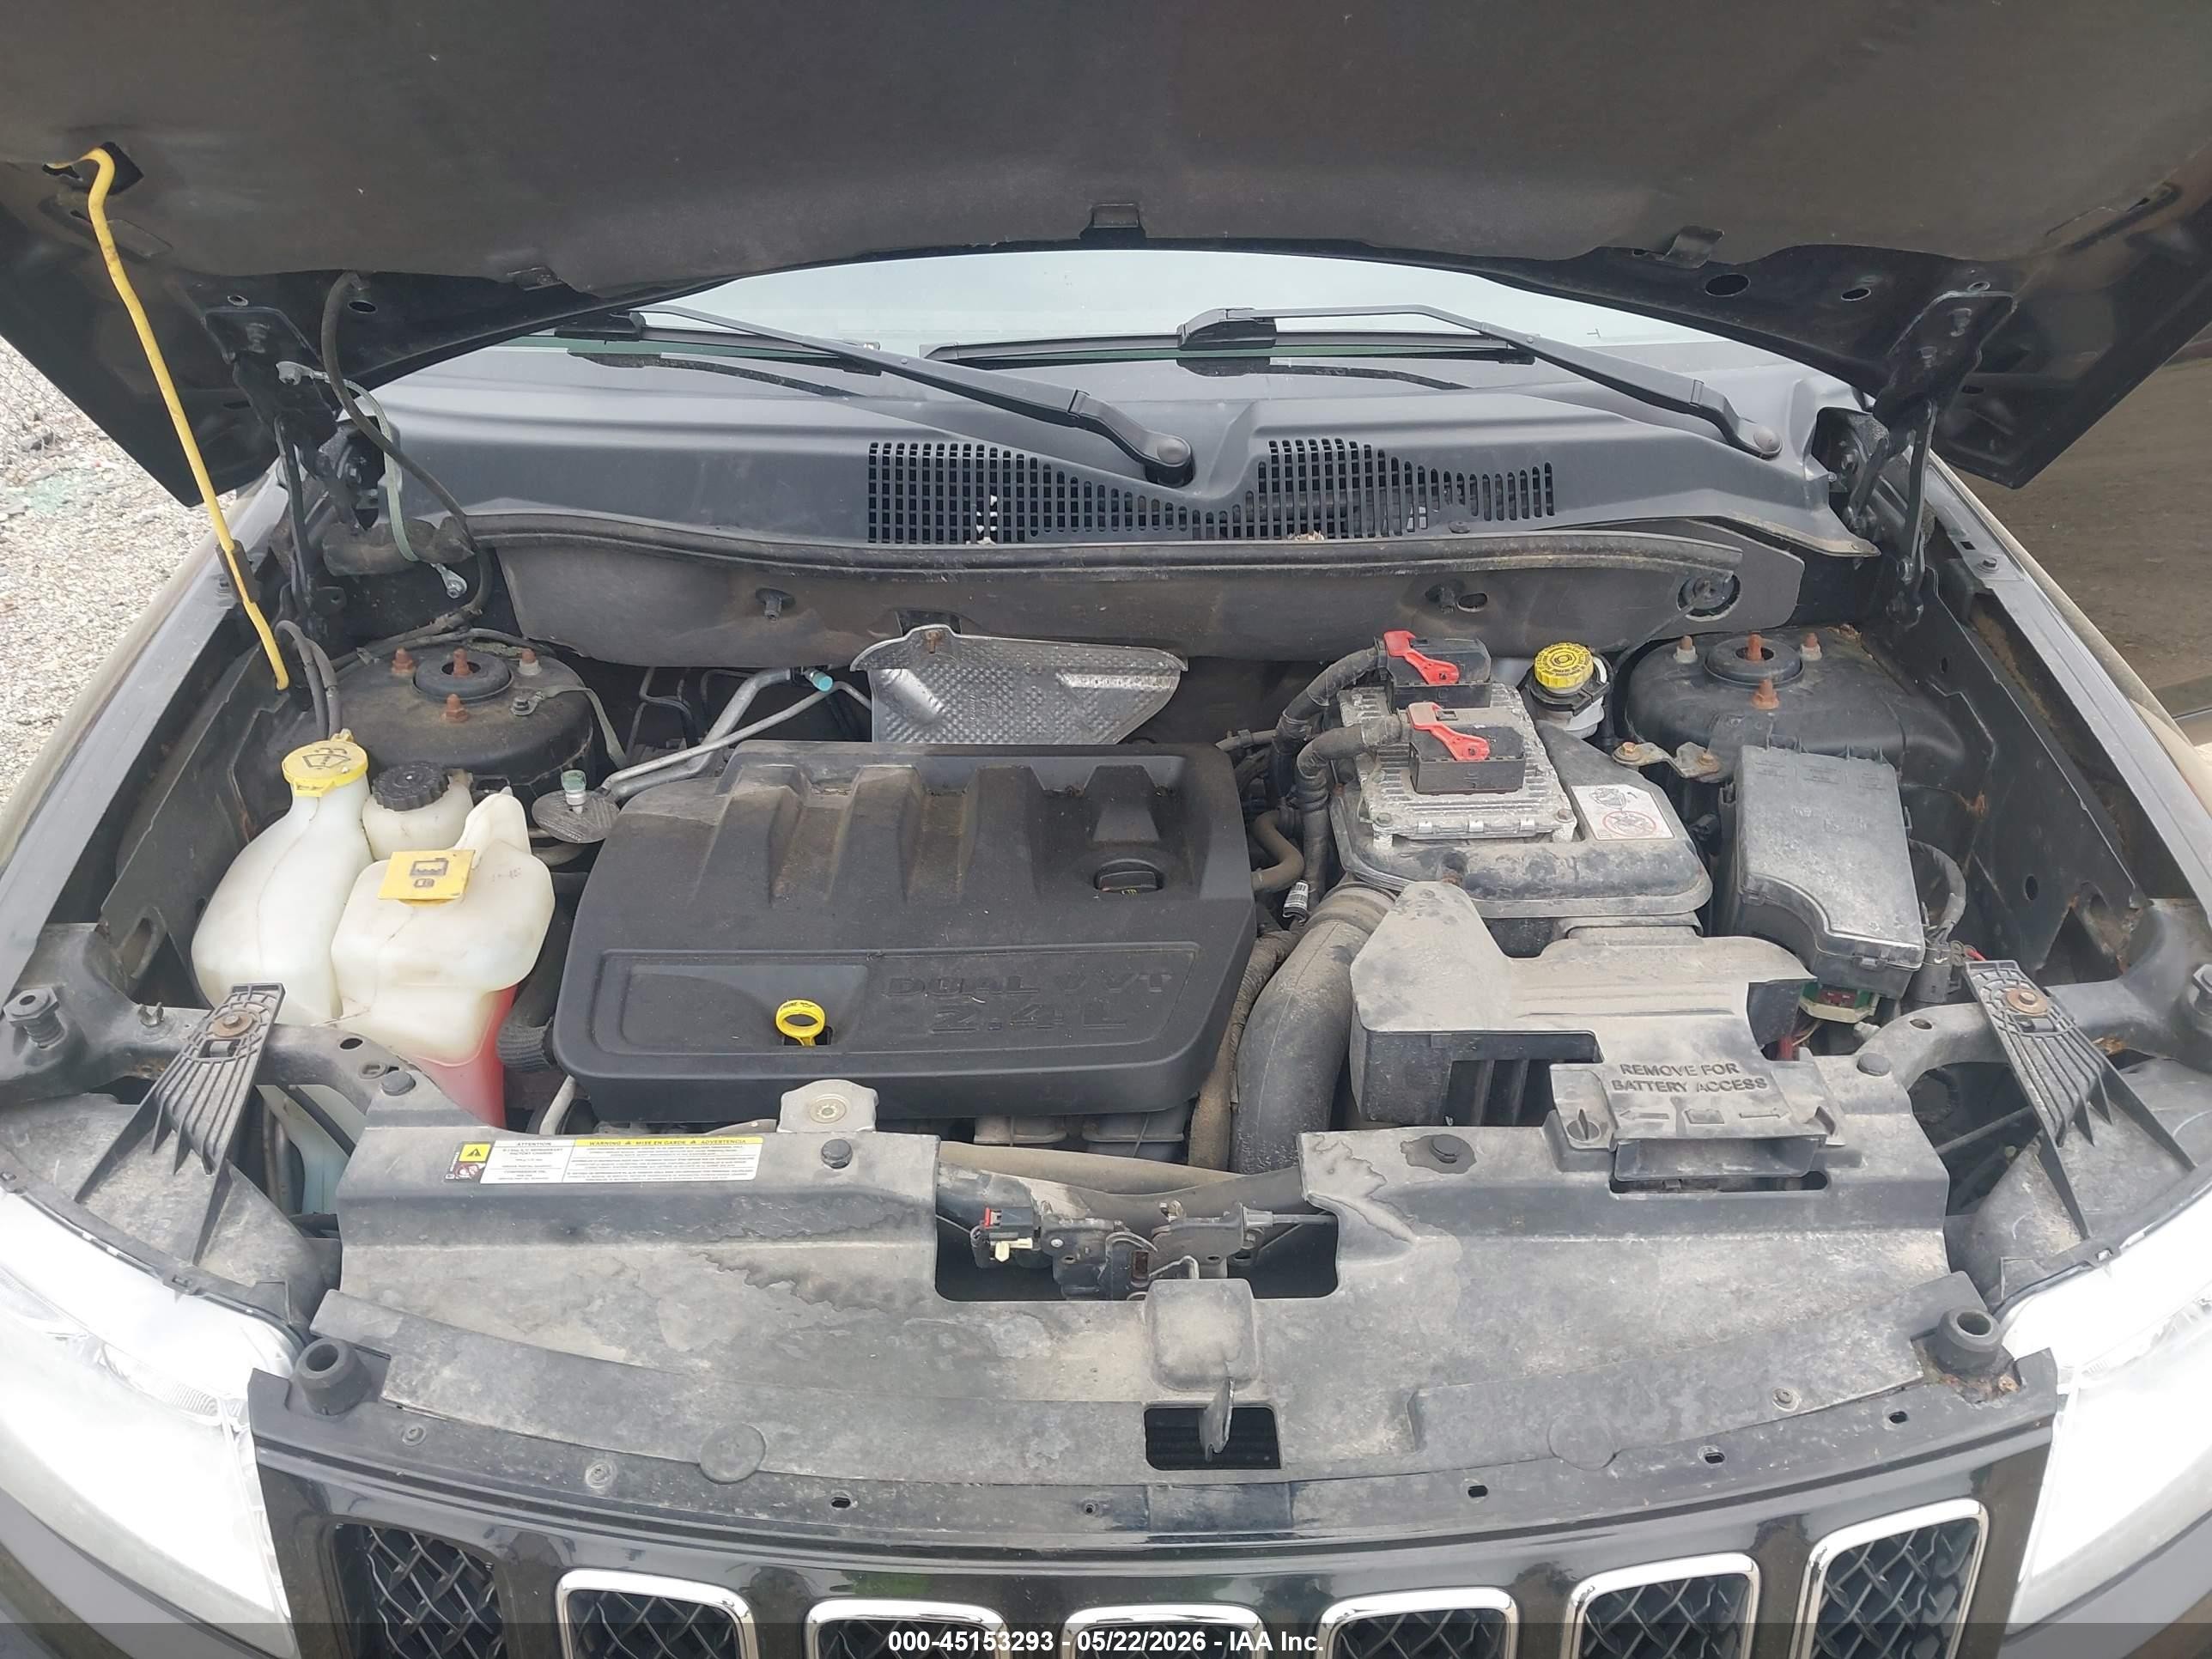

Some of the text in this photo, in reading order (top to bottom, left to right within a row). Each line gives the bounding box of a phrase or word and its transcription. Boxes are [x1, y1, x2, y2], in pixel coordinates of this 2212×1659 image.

[883, 971, 1173, 997] DUAL VVT
[1620, 1062, 1741, 1078] REMOVE FOR
[1611, 1077, 1768, 1093] BATTERY ACCESS
